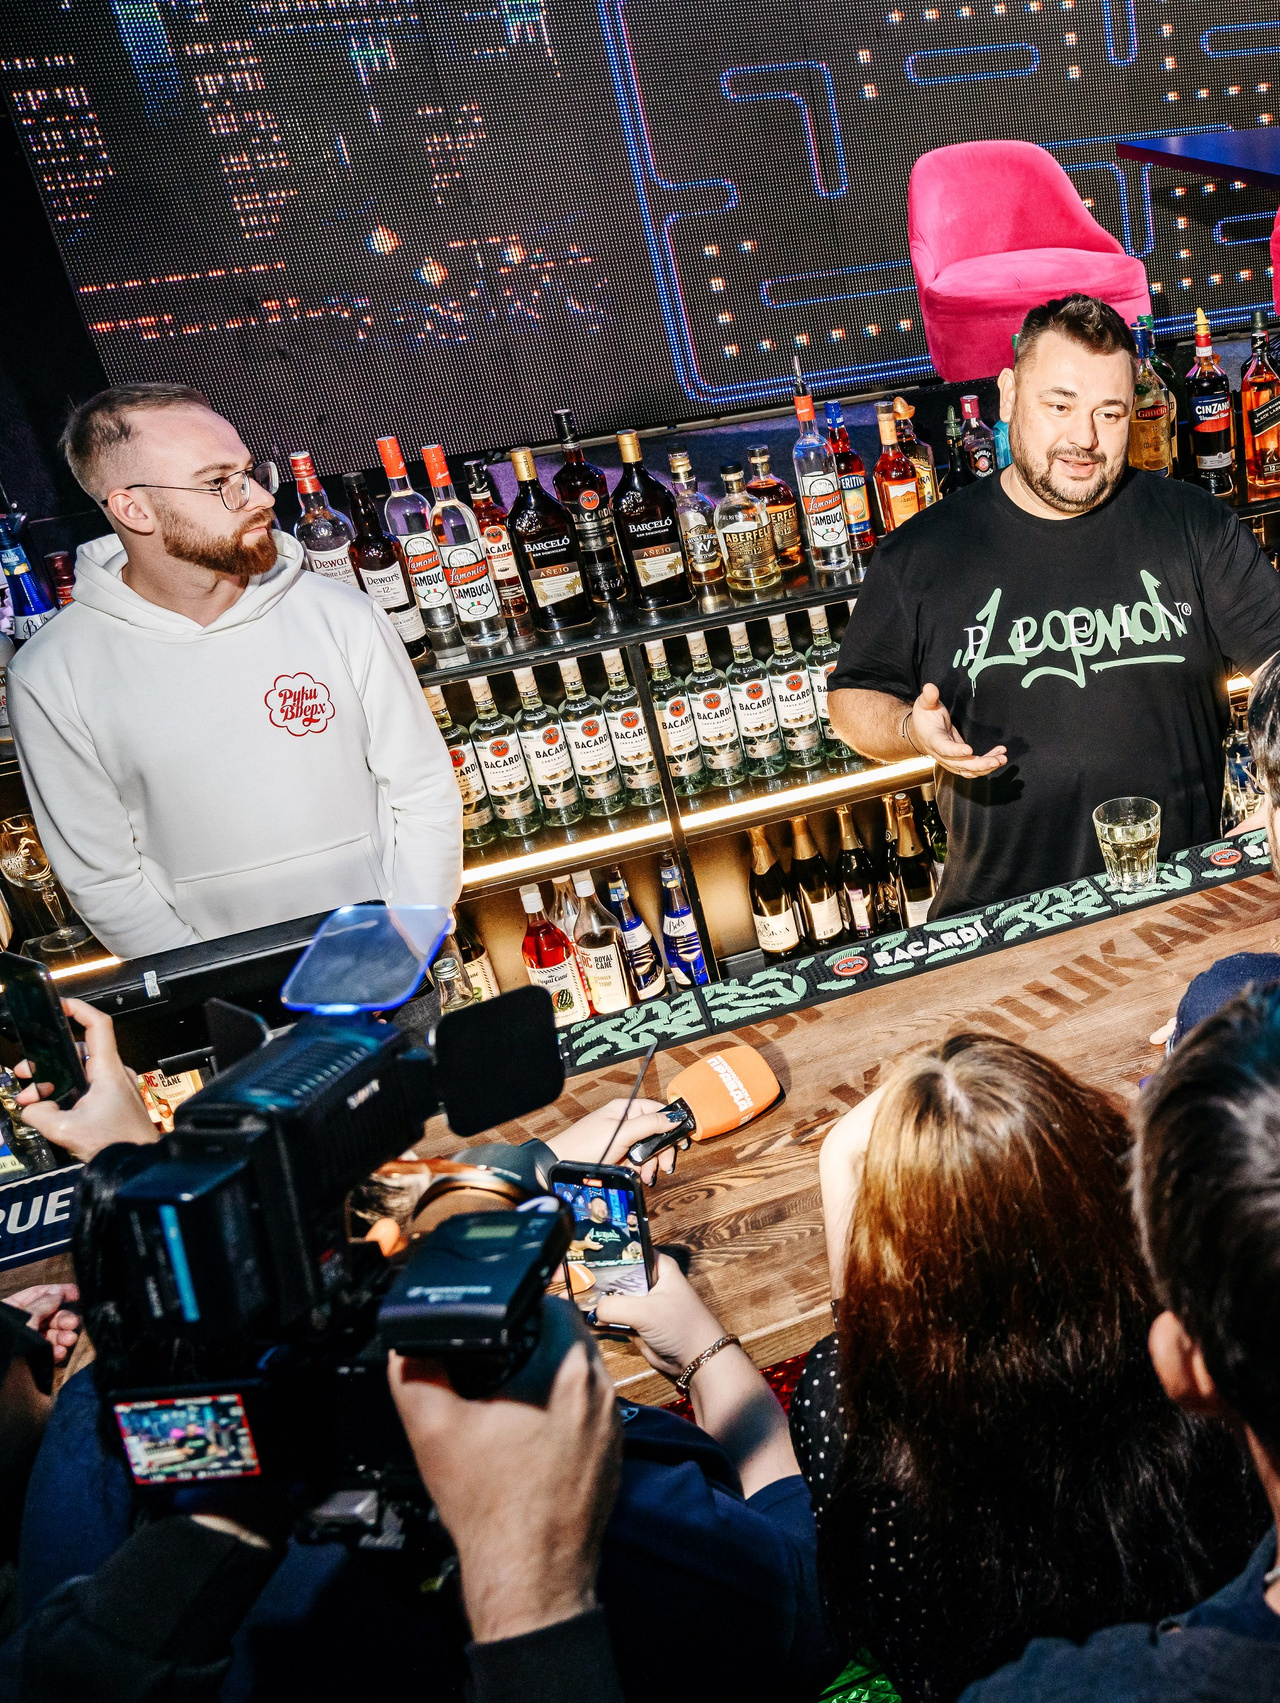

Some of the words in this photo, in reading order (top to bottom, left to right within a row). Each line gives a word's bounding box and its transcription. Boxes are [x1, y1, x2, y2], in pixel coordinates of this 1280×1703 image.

[1138, 406, 1167, 418] Gancia
[629, 517, 672, 534] BARCELÓ
[811, 511, 843, 527] SAMBUCA
[524, 535, 570, 553] BARCELÓ
[642, 547, 671, 558] AÑEJO
[539, 566, 570, 578] AÑEJO
[366, 572, 400, 586] Dewar's
[454, 582, 491, 600] SAMBUCA
[278, 686, 318, 708] Руки
[594, 953, 613, 963] ROYAL
[595, 961, 613, 970] CANE
[161, 1076, 182, 1088] CANE
